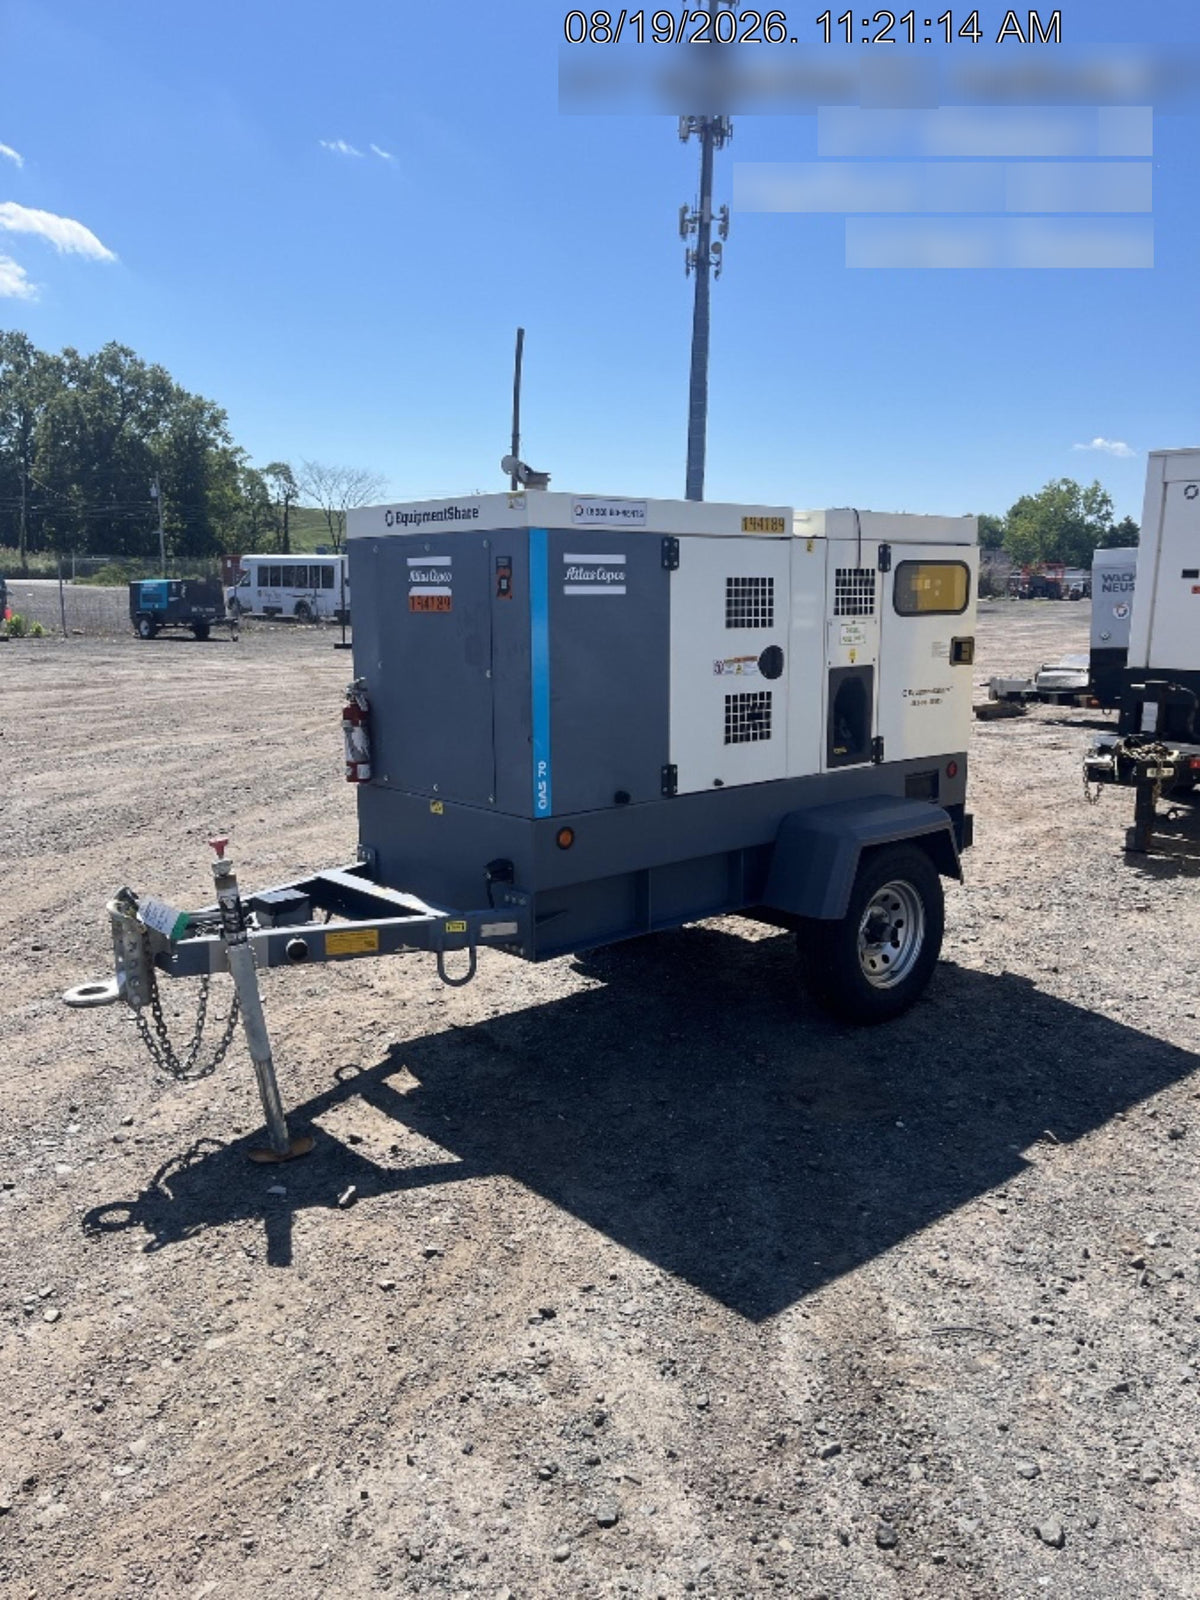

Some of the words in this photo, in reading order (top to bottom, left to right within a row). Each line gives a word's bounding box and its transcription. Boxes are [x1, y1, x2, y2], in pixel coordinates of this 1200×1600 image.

[396, 506, 479, 526] EquipmentShare
[564, 566, 597, 580] Atlas
[596, 566, 625, 584] Copco
[538, 760, 547, 778] 70
